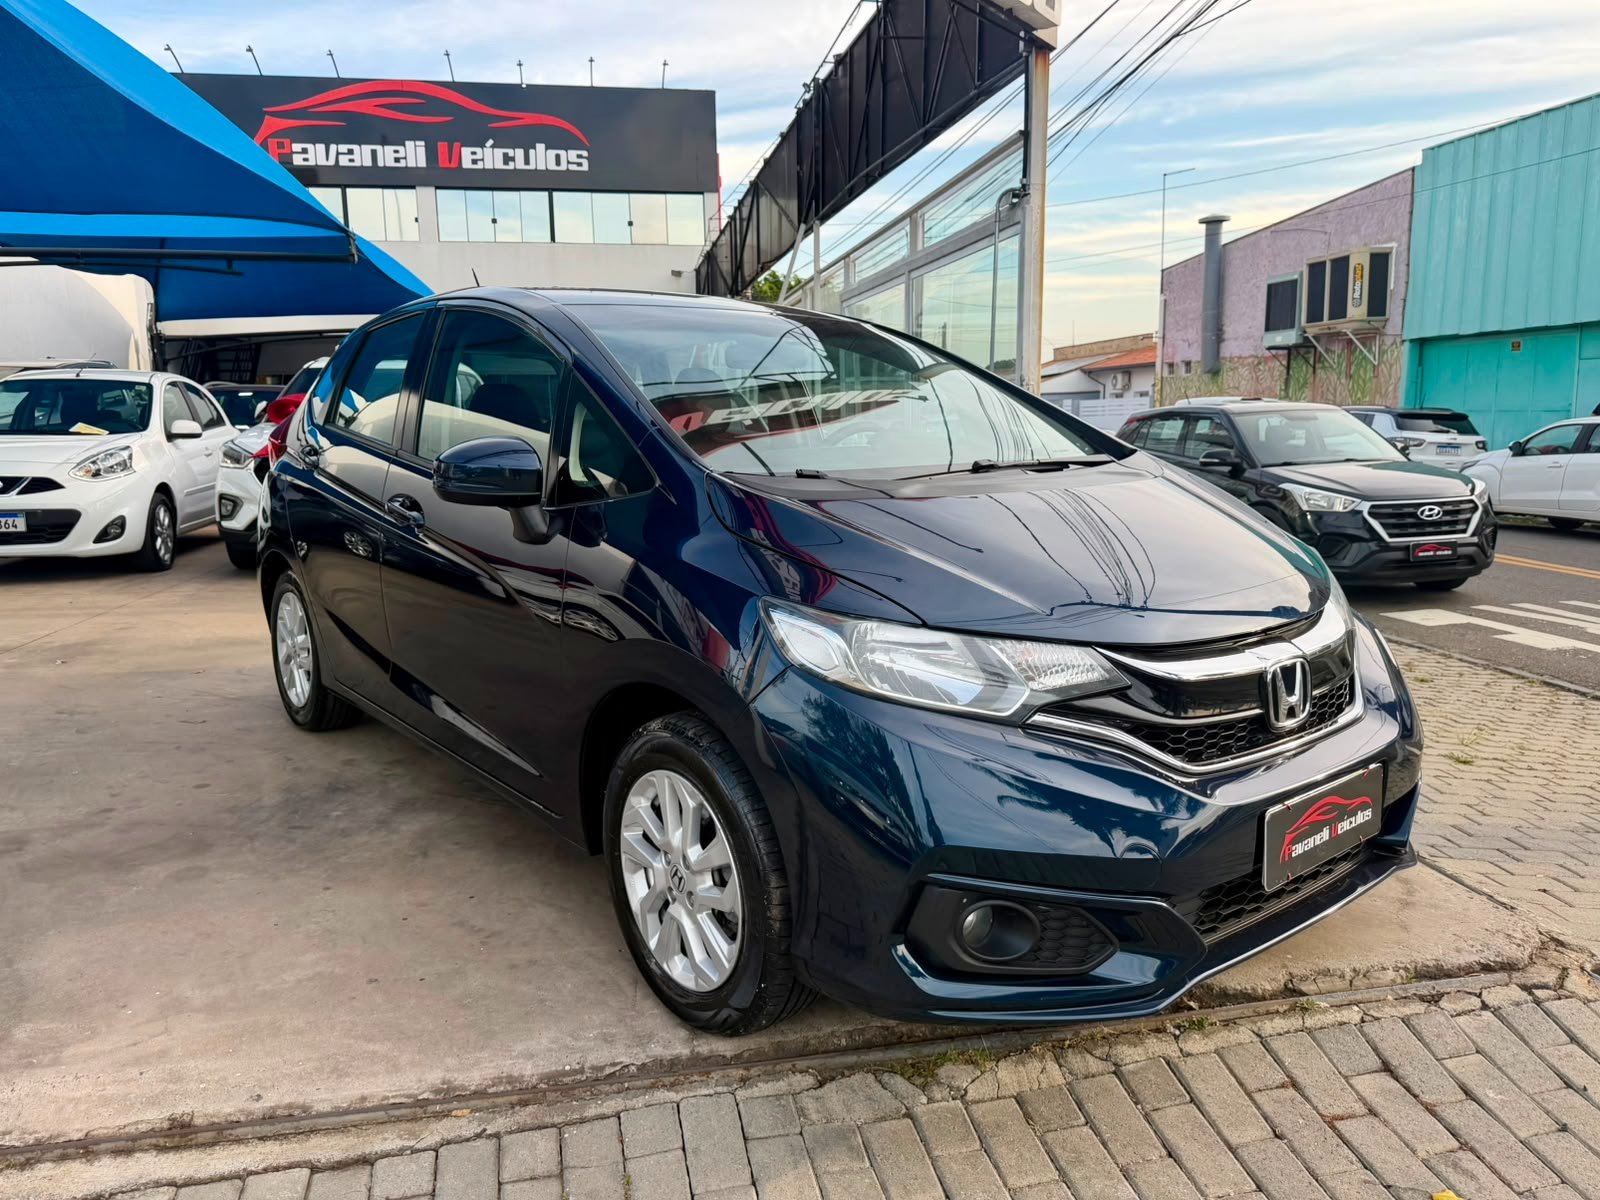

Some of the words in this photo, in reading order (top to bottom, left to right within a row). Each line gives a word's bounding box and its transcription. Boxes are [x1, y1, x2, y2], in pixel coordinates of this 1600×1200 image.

[267, 138, 426, 167] Pavaneli
[437, 138, 589, 171] Veículos
[1284, 825, 1330, 862] Pavaneli
[1331, 808, 1373, 838] Veículos
